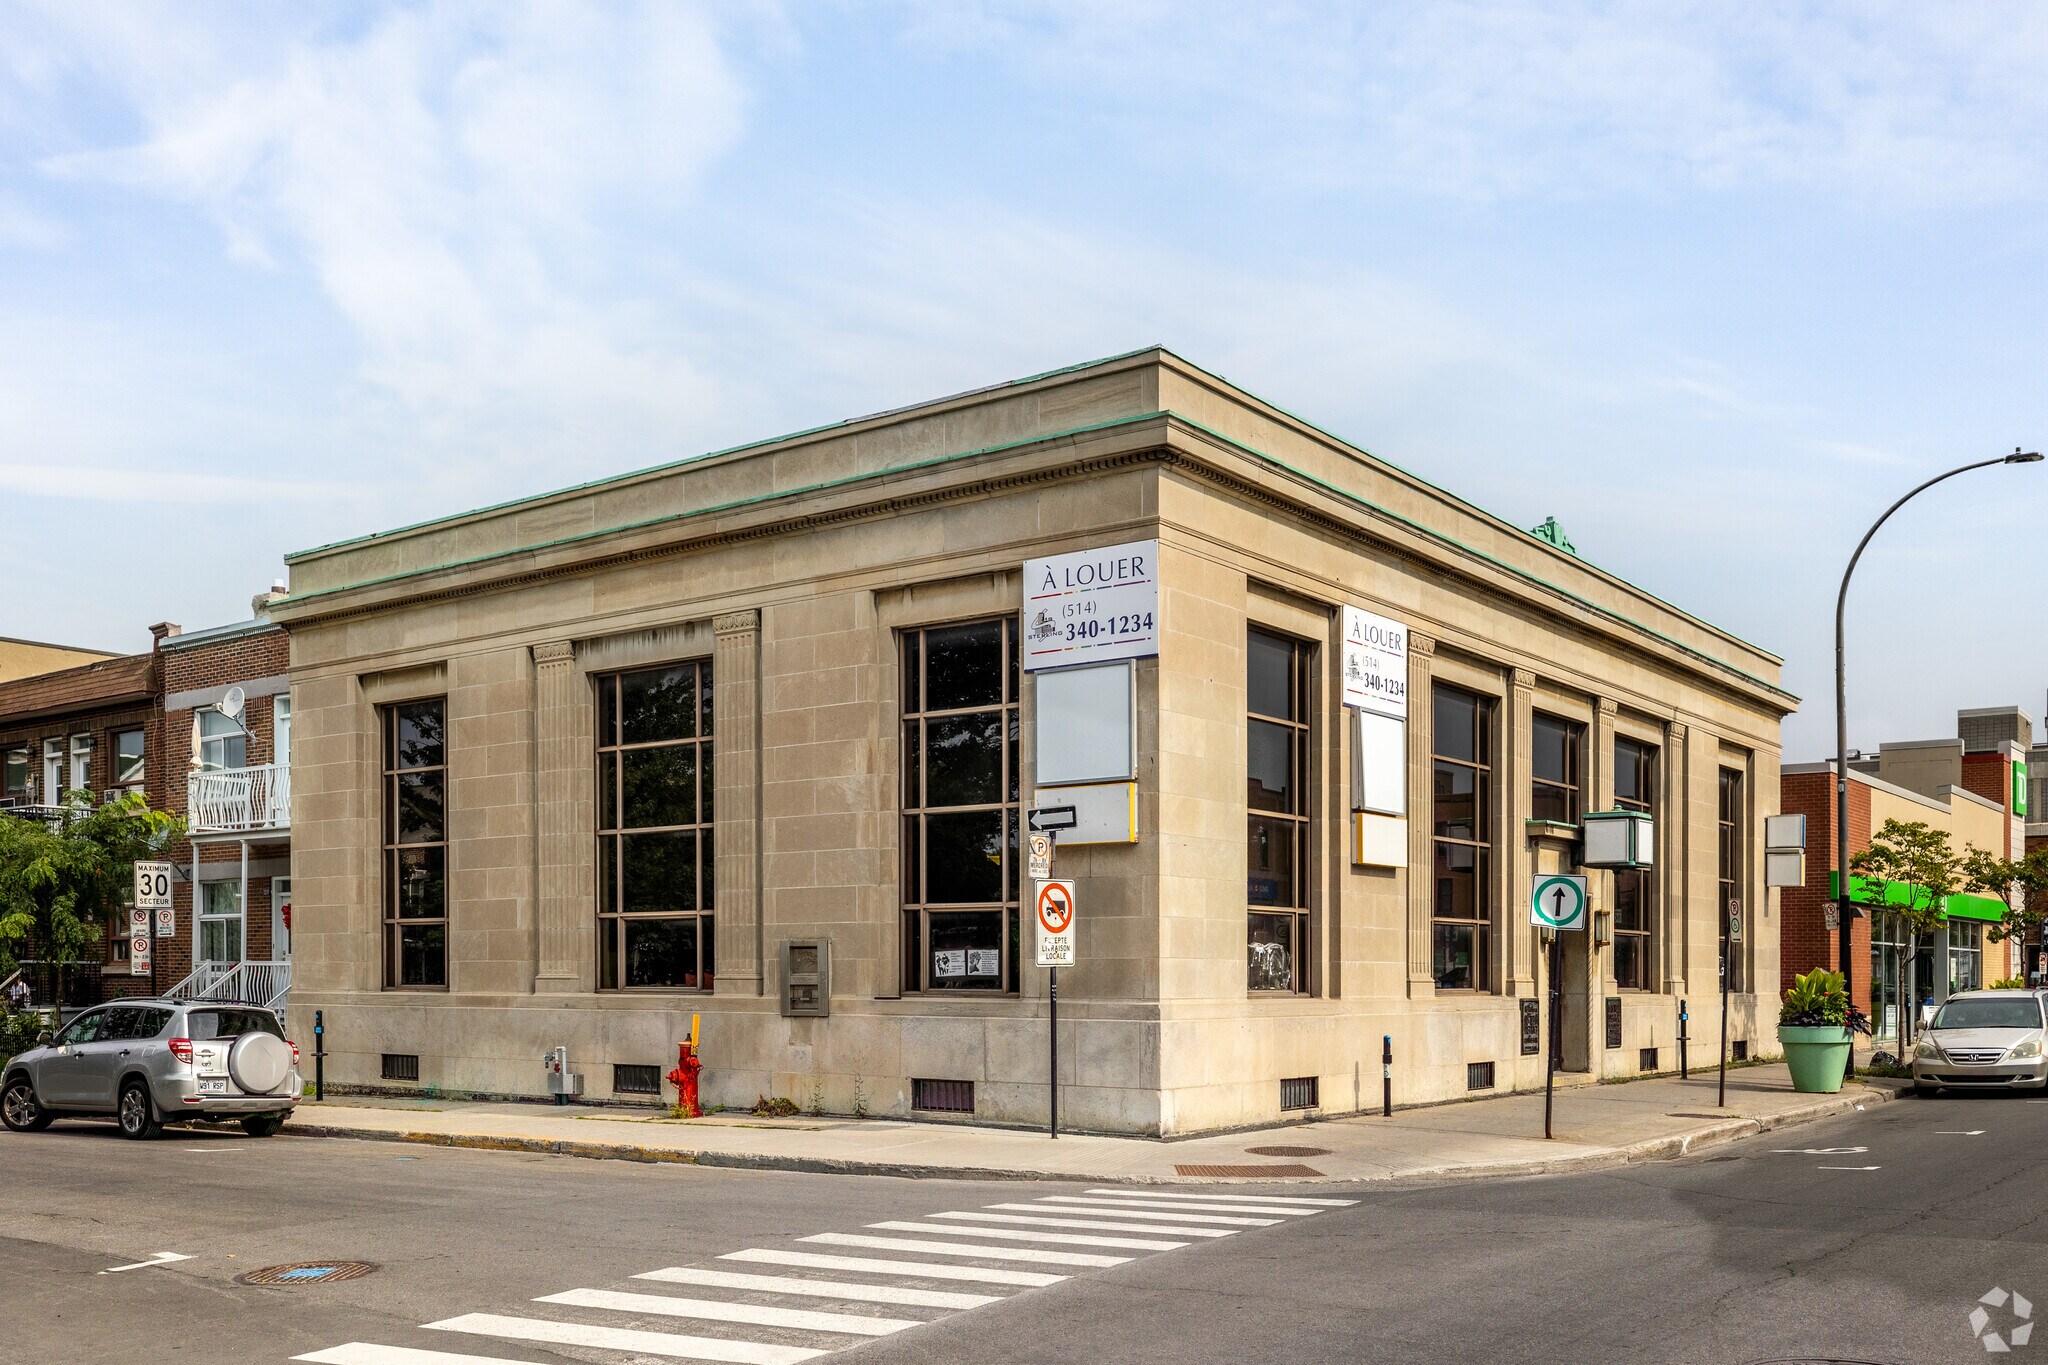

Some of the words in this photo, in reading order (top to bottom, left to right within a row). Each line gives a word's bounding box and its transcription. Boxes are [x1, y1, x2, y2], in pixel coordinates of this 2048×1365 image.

[1042, 565, 1057, 591] À
[1065, 556, 1145, 587] LOUER
[1062, 600, 1097, 619] (514)
[1066, 612, 1153, 641] 340-1234
[1352, 615, 1361, 639] À
[1364, 623, 1402, 651] LOUER
[1362, 655, 1380, 671] (514)
[1364, 672, 1405, 697] 340-1234
[2017, 771, 2027, 805] TD
[140, 873, 168, 896] 30
